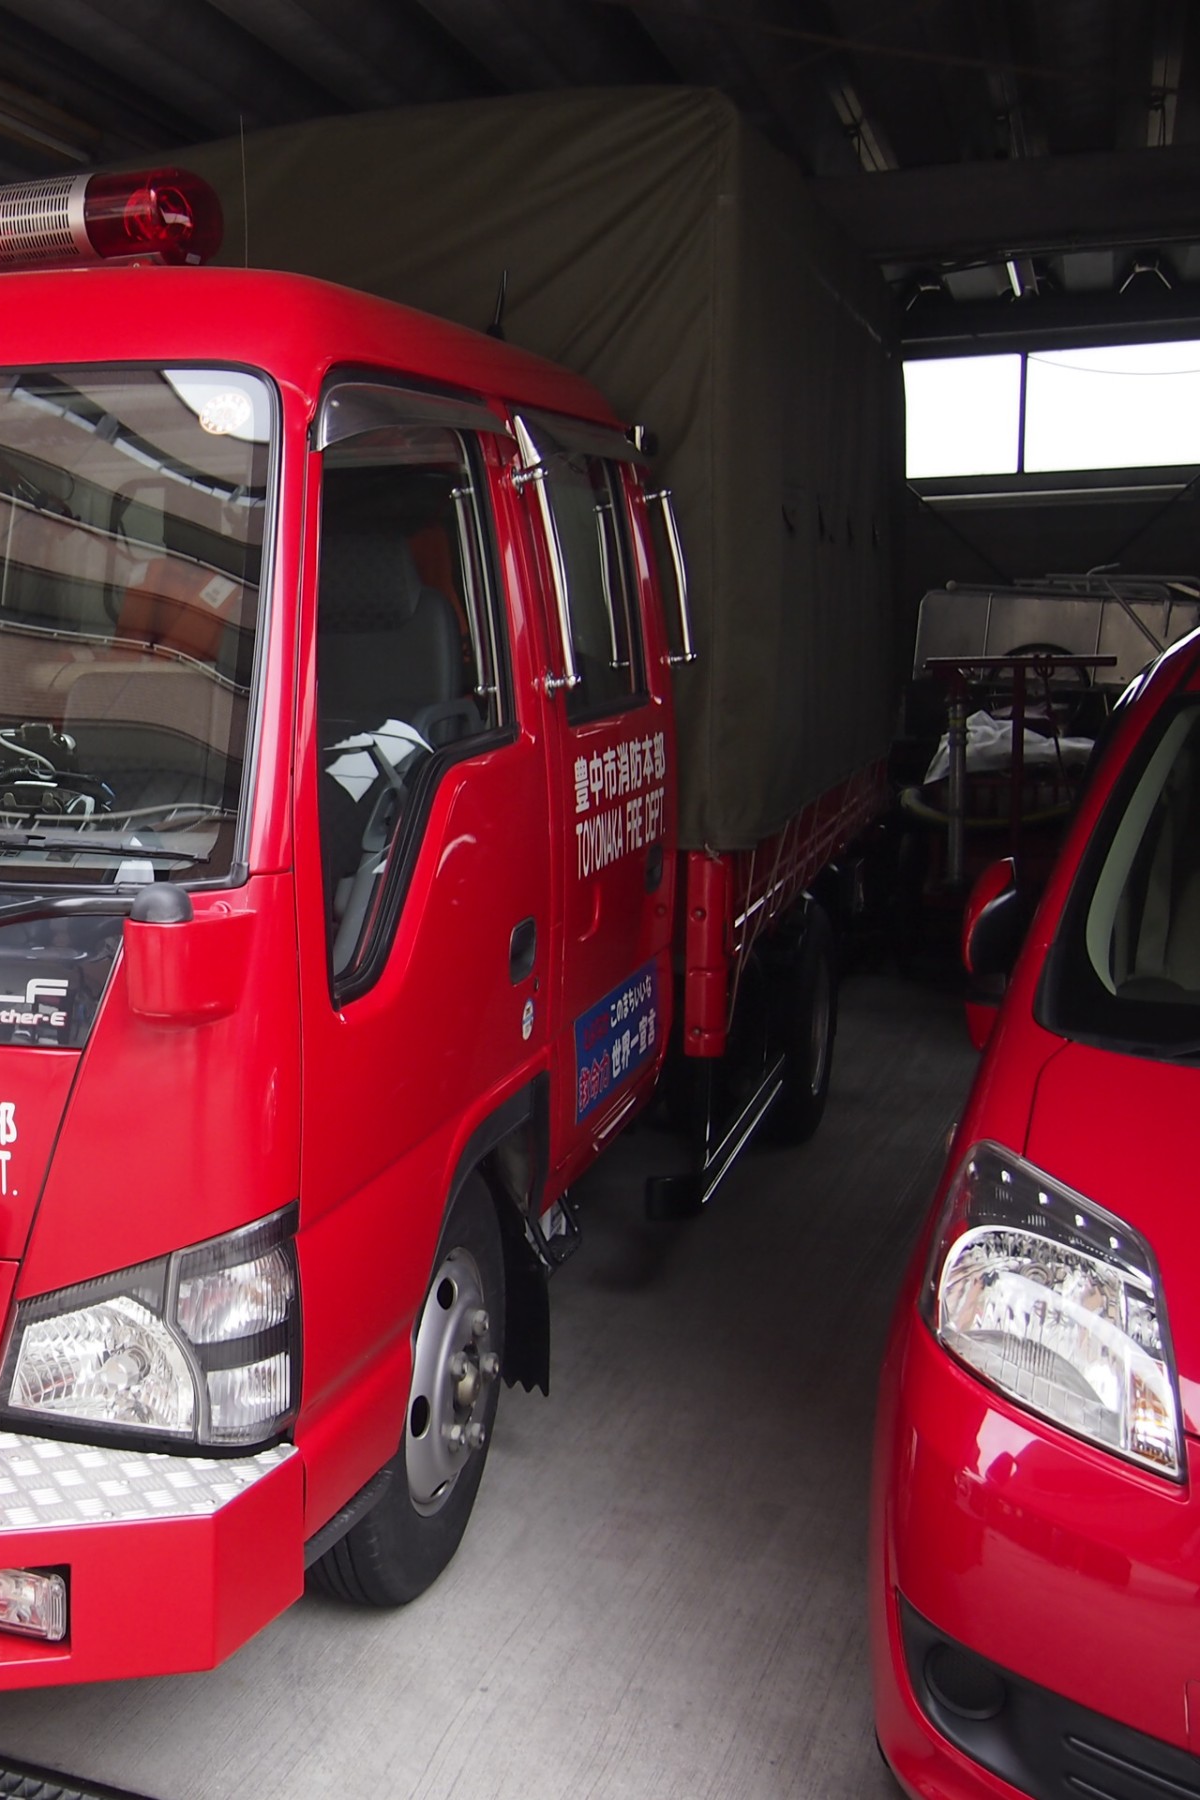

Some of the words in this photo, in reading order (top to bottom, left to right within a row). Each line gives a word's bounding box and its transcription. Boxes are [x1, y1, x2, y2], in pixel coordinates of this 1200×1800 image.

[574, 731, 666, 814] 豊中市消防本部
[575, 804, 624, 881] TOYONAKA
[626, 796, 643, 854] FIRE
[611, 974, 652, 1028] このまちいいな
